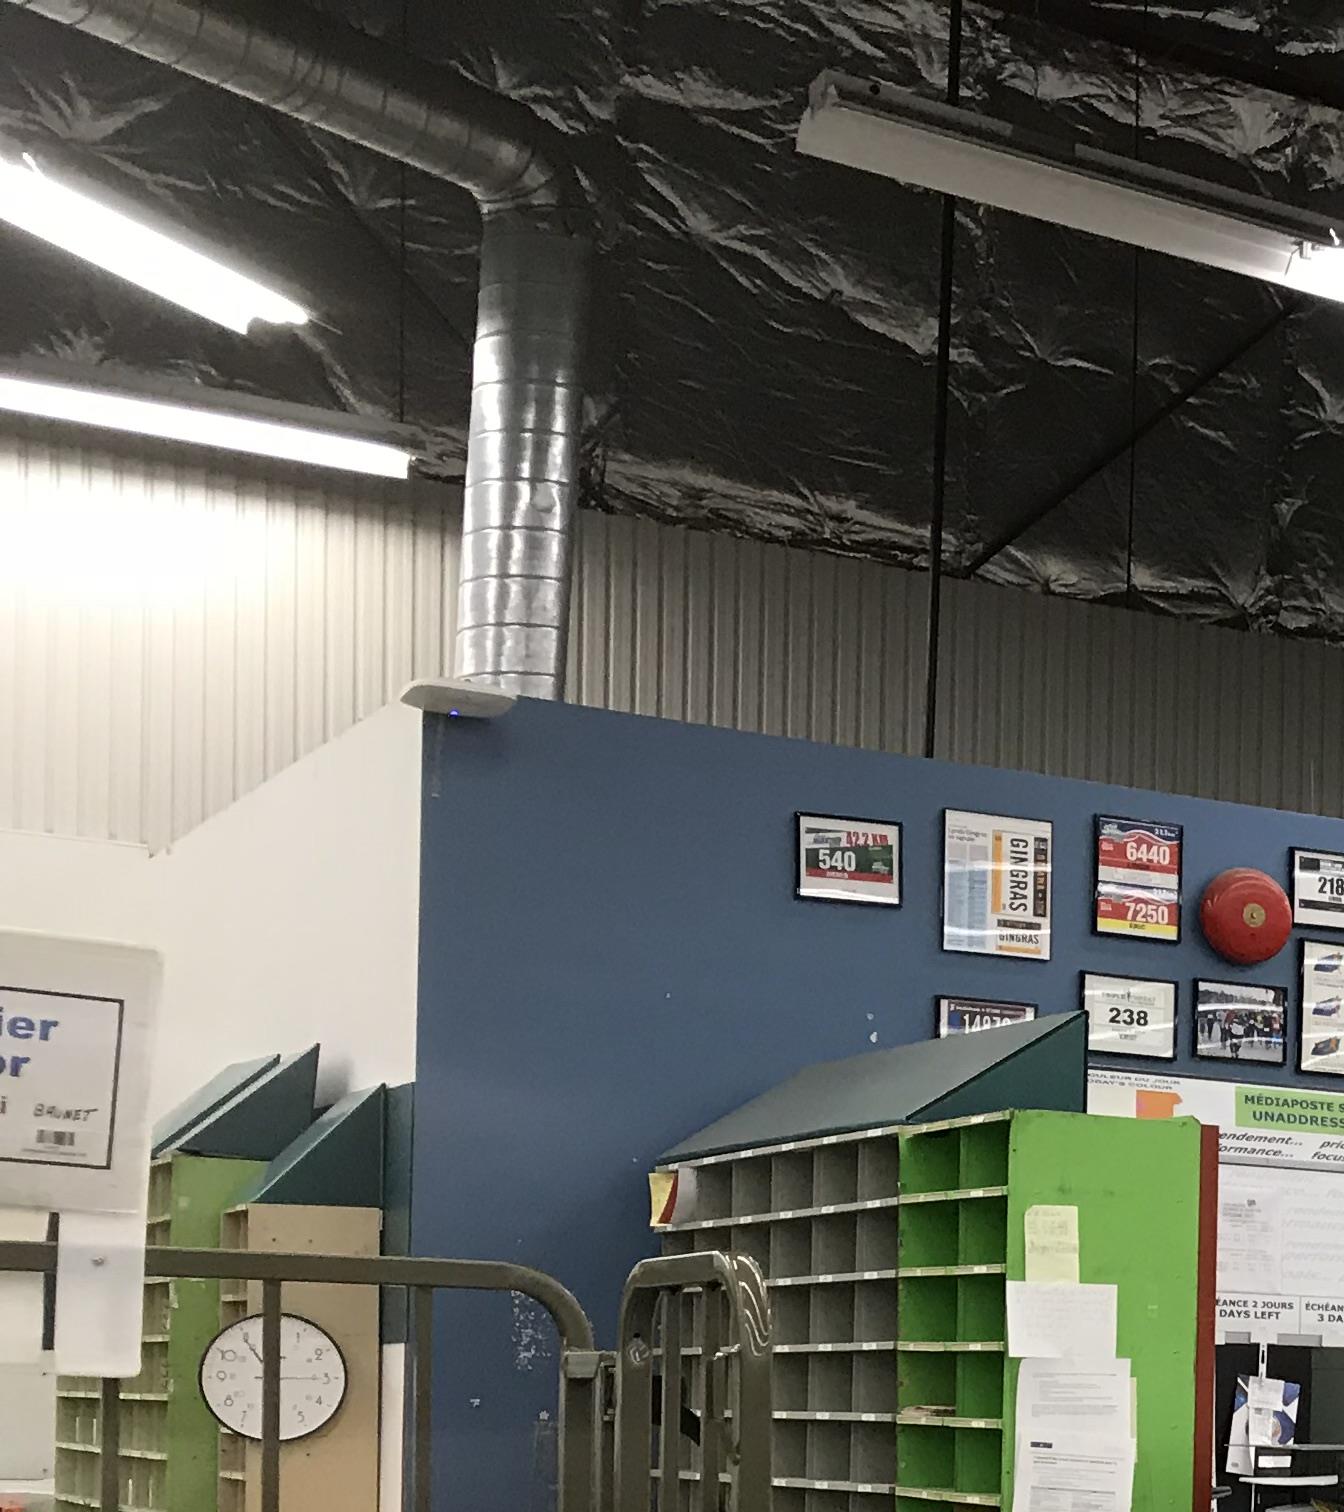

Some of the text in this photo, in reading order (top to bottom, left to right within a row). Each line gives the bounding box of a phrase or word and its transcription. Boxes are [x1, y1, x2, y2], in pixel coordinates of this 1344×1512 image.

[1126, 841, 1170, 865] 6440
[818, 848, 856, 872] 540
[1008, 838, 1029, 913] GINGRAS
[1125, 902, 1169, 924] 7250
[0, 1006, 59, 1041] er
[1108, 1007, 1149, 1027] 238
[0, 1055, 31, 1078] r
[1088, 1072, 1132, 1081] OULEUR
[1088, 1079, 1126, 1087] ODAY'S
[1244, 1093, 1334, 1112] MÉDIAPOSTE
[1217, 1132, 1303, 1146] endement...
[1251, 1300, 1258, 1308] 2
[1260, 1301, 1295, 1311] JOURS
[1219, 1309, 1281, 1321] DAYS LEFT
[1317, 1313, 1325, 1322] 3
[217, 1347, 238, 1362] 10
[315, 1348, 323, 1361] 2
[216, 1370, 227, 1383] 9
[322, 1372, 332, 1385] 3
[223, 1394, 234, 1407] 8
[315, 1395, 323, 1406] 4
[297, 1410, 305, 1423] 5
